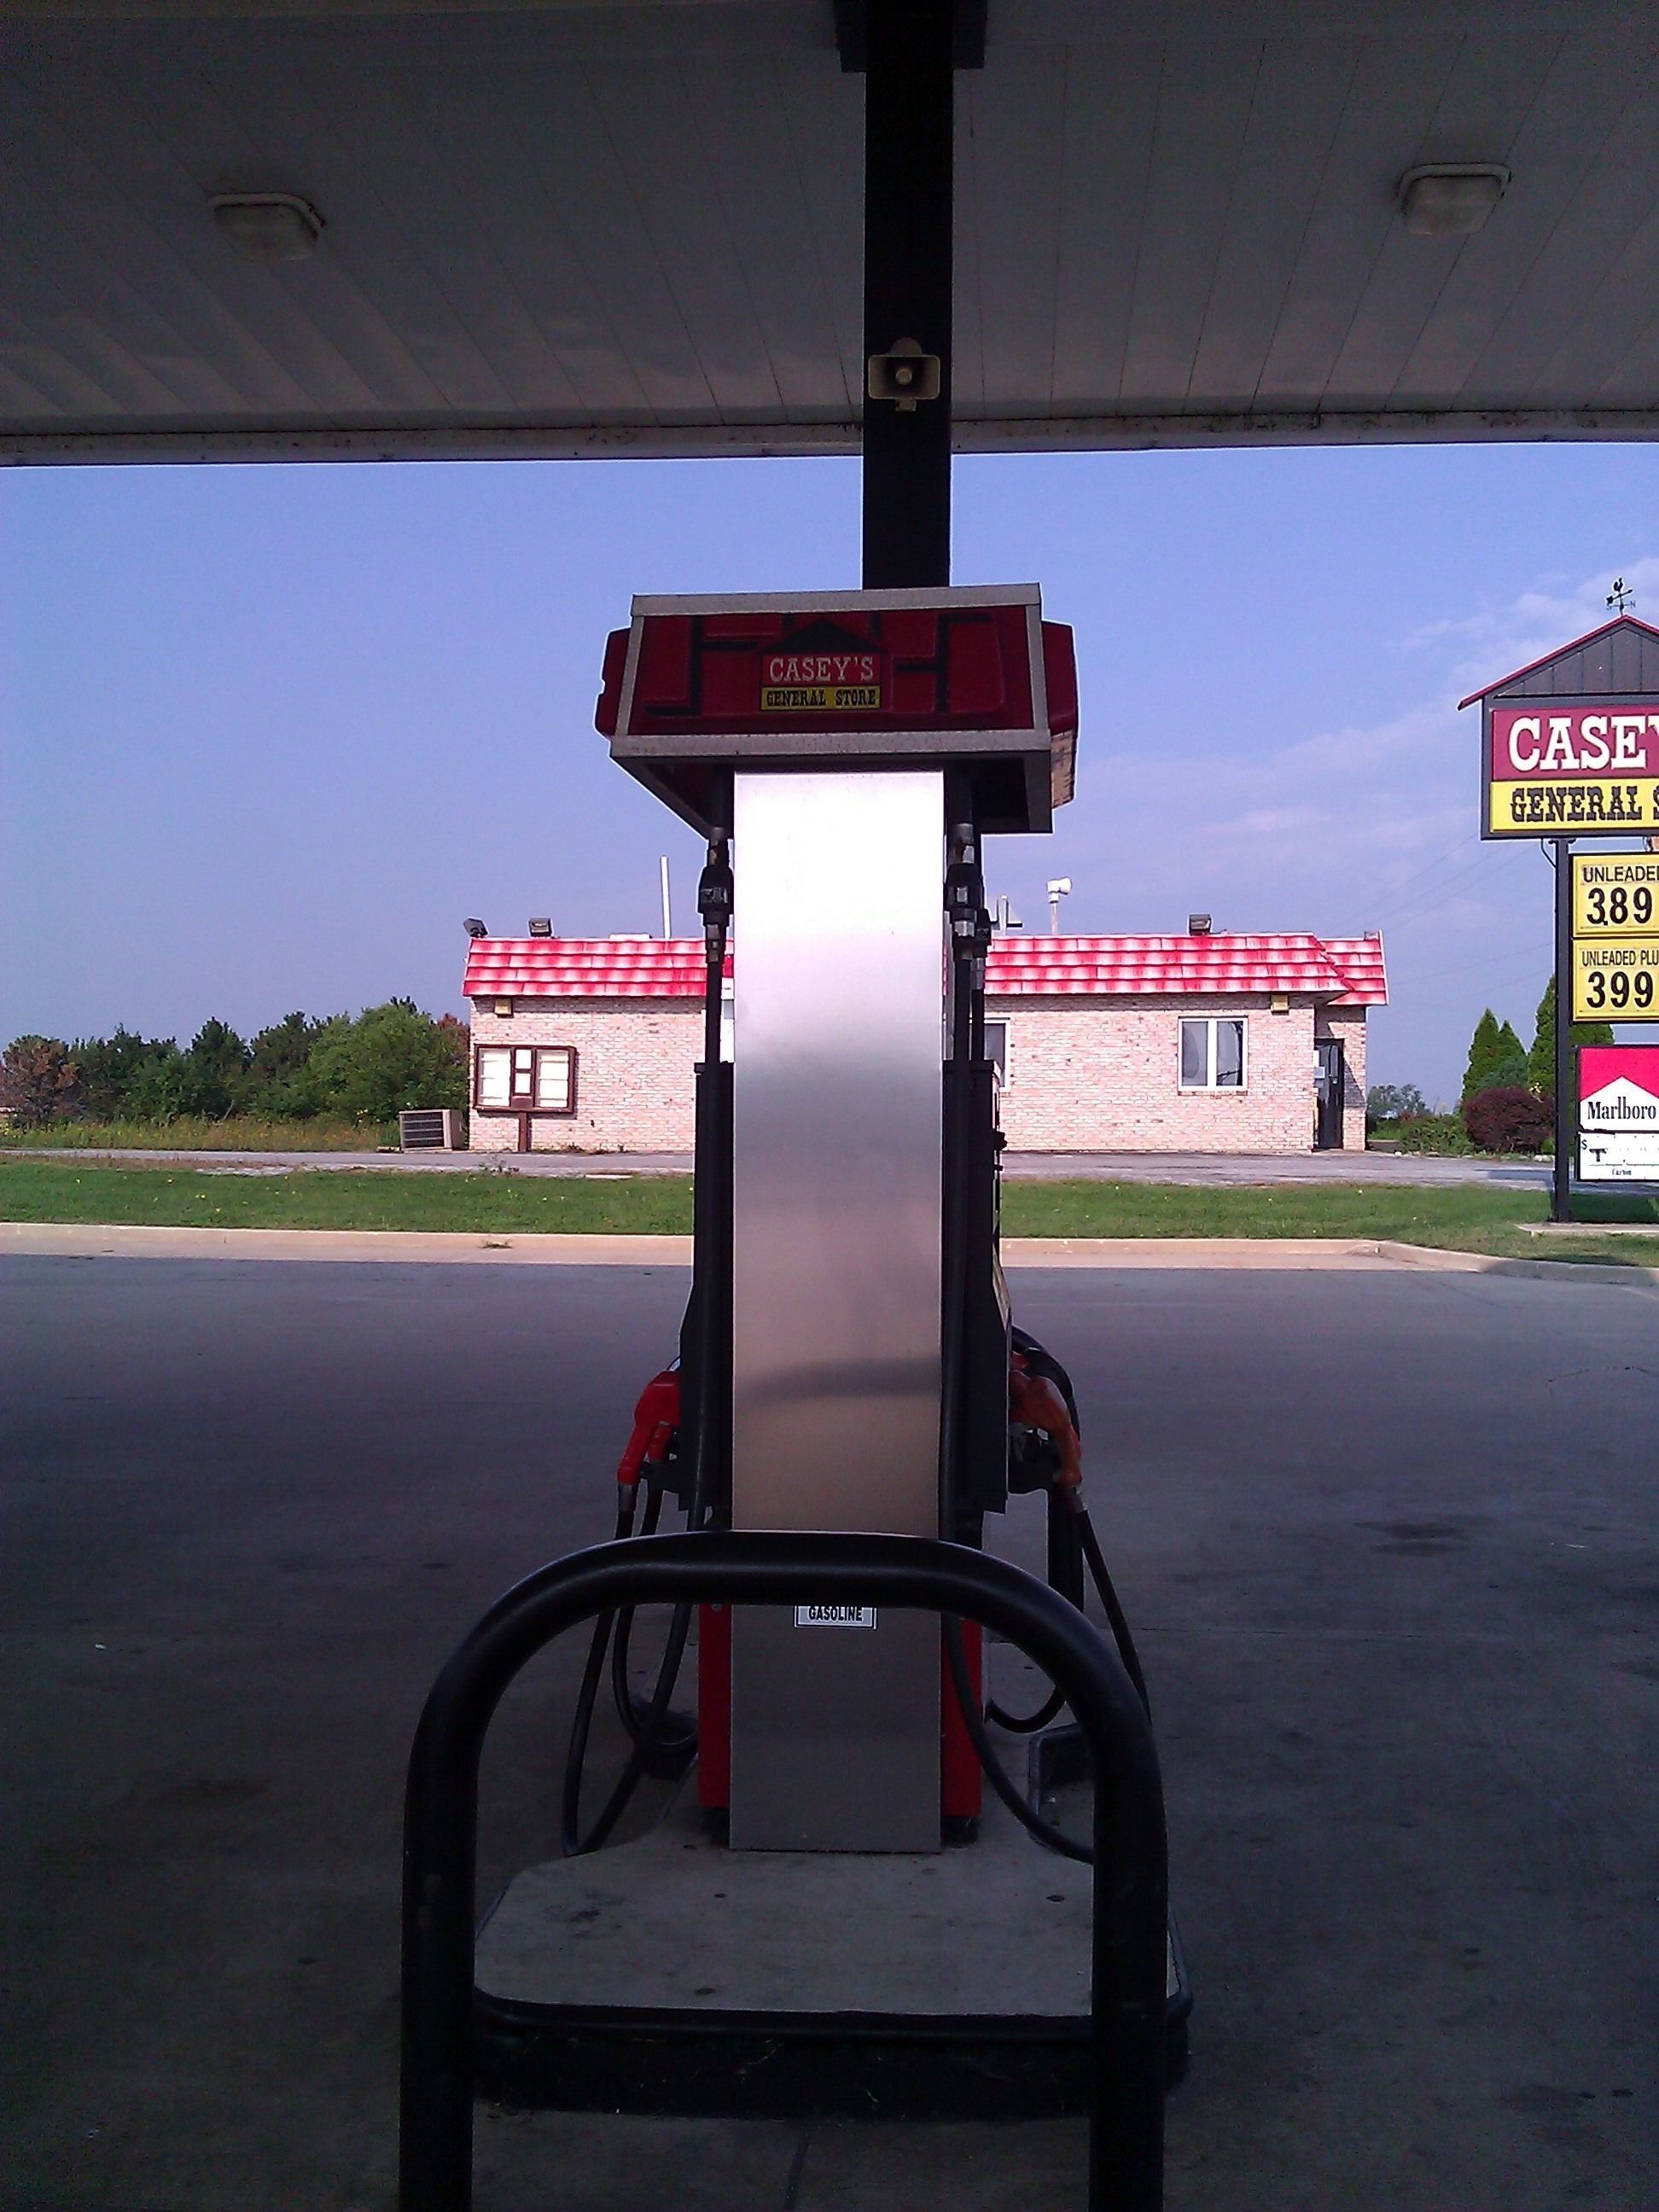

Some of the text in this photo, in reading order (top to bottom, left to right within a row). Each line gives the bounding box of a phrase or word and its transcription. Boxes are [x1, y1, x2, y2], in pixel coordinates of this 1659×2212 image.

[770, 656, 874, 682] CASEY'S
[766, 689, 876, 707] GENERAL STORE
[1511, 785, 1643, 822] GENERAL
[1581, 950, 1636, 967] UNLEADED
[1587, 1096, 1656, 1120] Marlboro
[808, 1605, 863, 1621] GASOLINE
